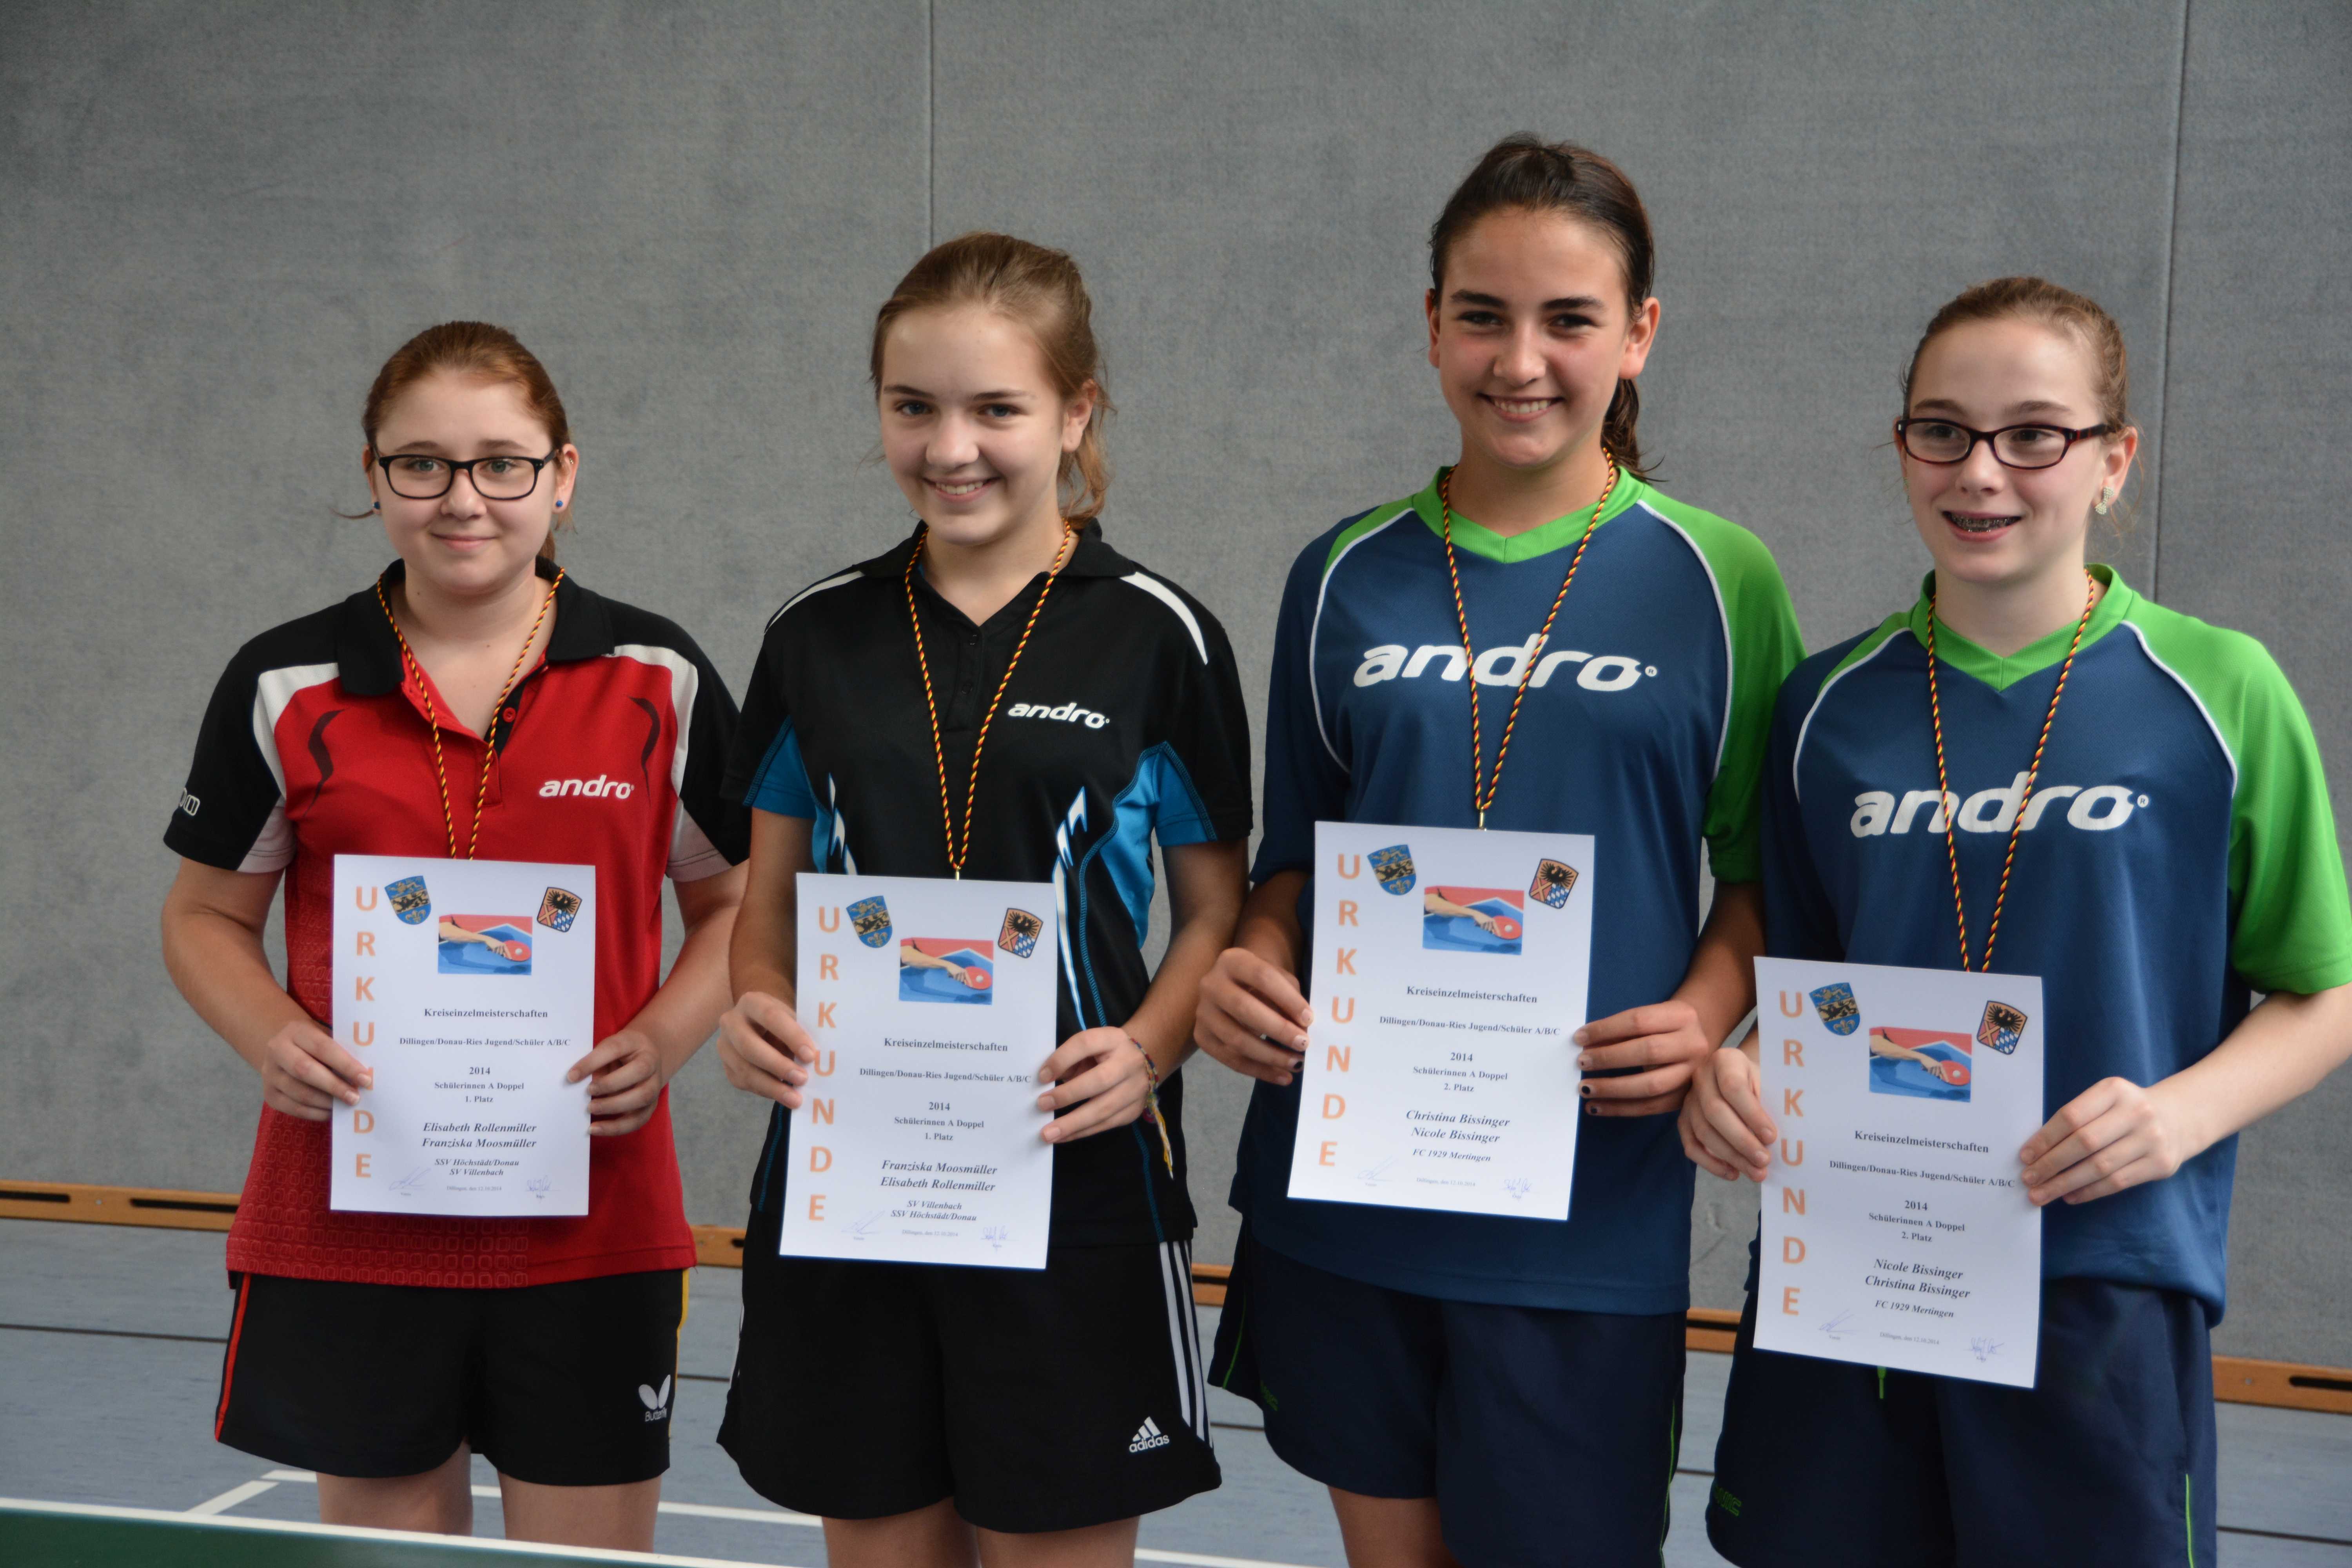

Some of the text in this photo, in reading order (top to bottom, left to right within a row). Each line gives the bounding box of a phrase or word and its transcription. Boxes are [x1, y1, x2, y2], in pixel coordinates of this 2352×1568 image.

[1354, 633, 1642, 691] andro
[1008, 702, 1105, 728] andro
[539, 775, 631, 799] andro
[1851, 771, 2134, 838] andro
[1407, 986, 1537, 1003] Kreiseinzelmeisterschaften
[424, 1008, 548, 1018] Kreiseinzelmeisterschaften
[1319, 854, 1360, 1166] URKUNDE
[1380, 1016, 1466, 1029] Dillingen/Donau-Ries
[1468, 1022, 1532, 1034] Jugend/Schüler
[400, 1038, 483, 1046] Dillingen/Donau-Ries
[485, 1038, 544, 1047] Jugend/Schüler
[884, 1038, 1007, 1051] Kreiseinzelmeisterschaften
[808, 906, 840, 1221] URKUNDE
[1450, 1052, 1473, 1062] 2014
[469, 1067, 490, 1075] 2014
[860, 1068, 942, 1079] Dillingen/Donau-Ries
[944, 1072, 1005, 1082] Jugend/Schüler
[1413, 1066, 1466, 1077] Schülerinnen
[1479, 1071, 1508, 1081] Doppel
[497, 1082, 524, 1091] Doppel
[1454, 1083, 1474, 1092] Platz
[929, 1102, 950, 1111] 2014
[894, 1116, 945, 1126] Schülerinnen
[956, 1120, 984, 1129] Doppel
[1406, 1110, 1510, 1128] Christina Bissinger
[423, 1123, 537, 1132] Elisabeth Rollenmiller
[421, 1138, 537, 1148] Franziska Moosmüller
[934, 1133, 953, 1141] Platz
[1411, 1127, 1500, 1144] Nicole Bissinger
[1855, 1130, 1988, 1153] Kreiseinzelmeisterschaften
[1449, 1152, 1490, 1162] Mertingen
[1779, 990, 1806, 1316] URKUNDE
[881, 1160, 997, 1174] Franziska Moosmüller
[1830, 1160, 2014, 1187] Dillingen/Donau-Ries Jugend/Schüler A/B/C
[880, 1176, 996, 1191] Elisabeth Rollenmiller
[922, 1201, 962, 1210] Villenbach
[1905, 1200, 1928, 1211] 2014
[909, 1211, 977, 1221] Höchstädt/Donau
[1869, 1212, 1923, 1226] Schülerinnen
[1936, 1221, 1965, 1232] Doppel
[1911, 1232, 1932, 1242] Platz
[1873, 1259, 1963, 1280] Nicole Bissinger
[1865, 1275, 1970, 1299] Christina Bissinger
[1875, 1300, 1954, 1318] FC 1929 Mertingen
[1129, 1435, 1169, 1452] adidas
